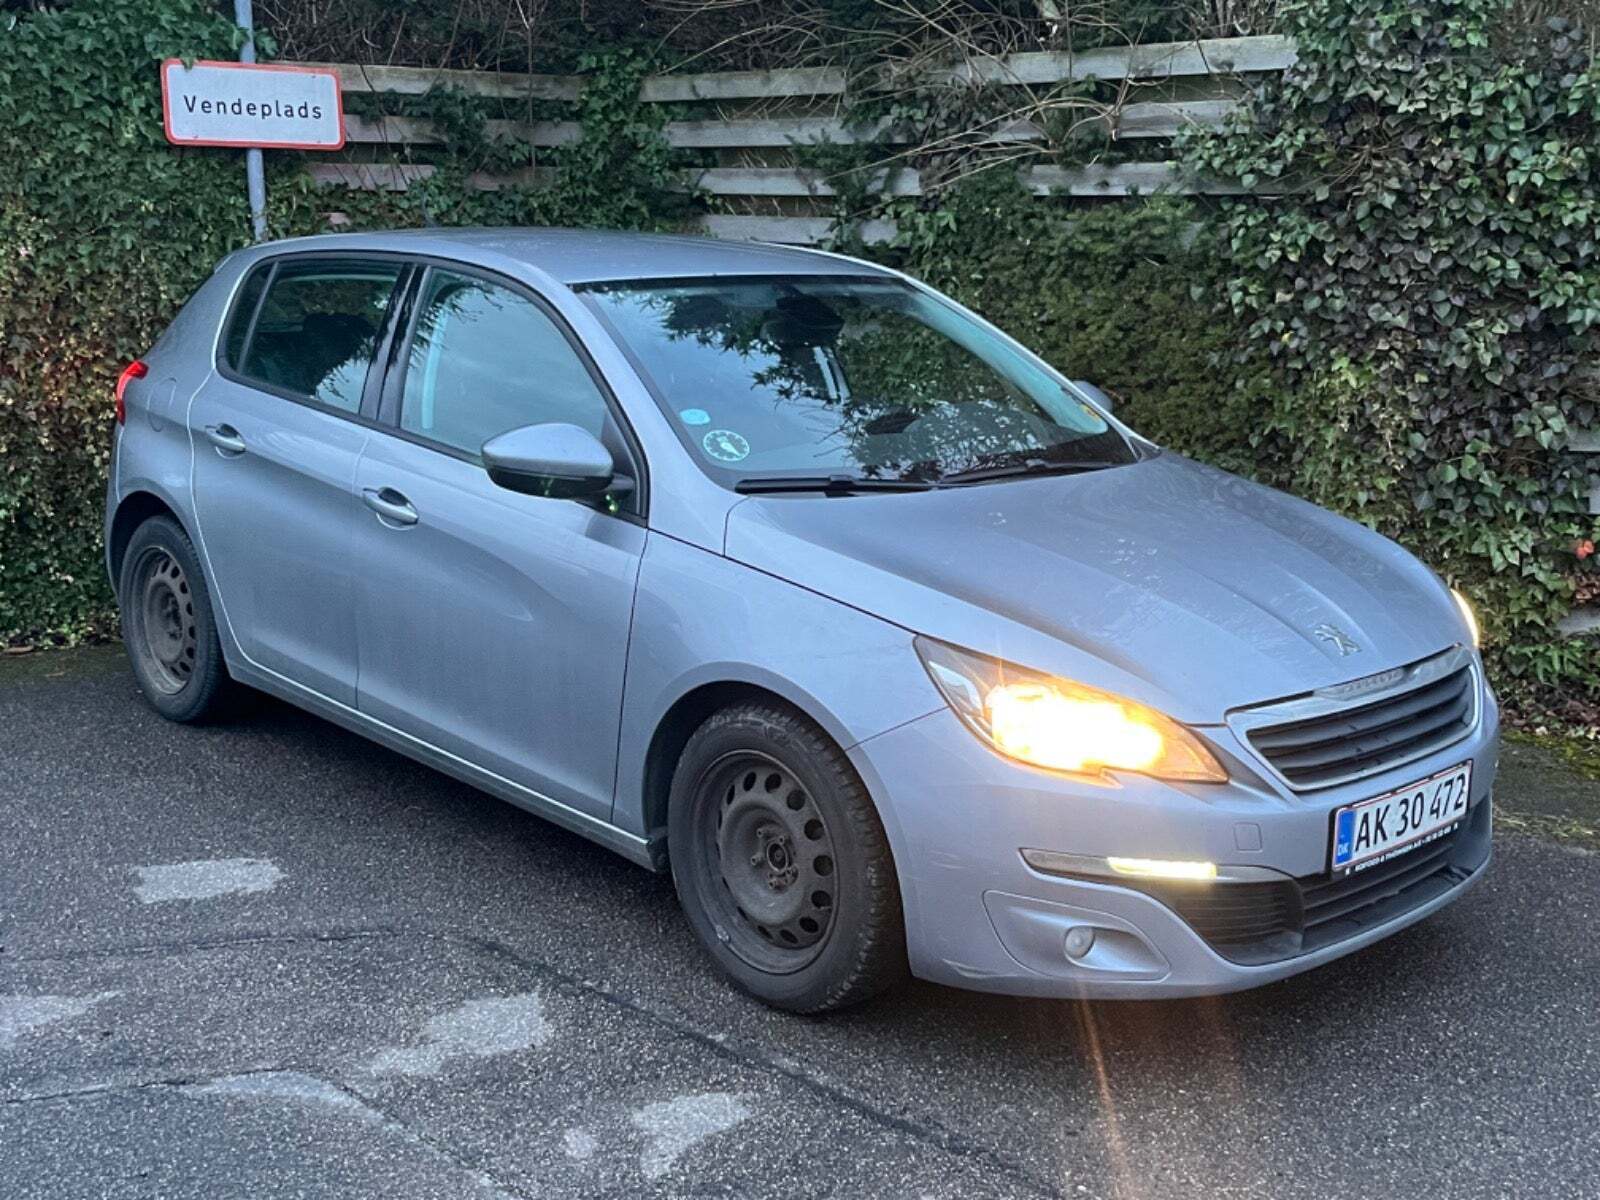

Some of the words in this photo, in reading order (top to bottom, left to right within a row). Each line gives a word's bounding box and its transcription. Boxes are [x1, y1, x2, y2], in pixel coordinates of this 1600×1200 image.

[184, 95, 322, 119] Vendeplads
[1355, 804, 1391, 852] AK
[1396, 792, 1425, 837] 30
[1429, 773, 1466, 820] 472
[1337, 842, 1350, 857] DK
